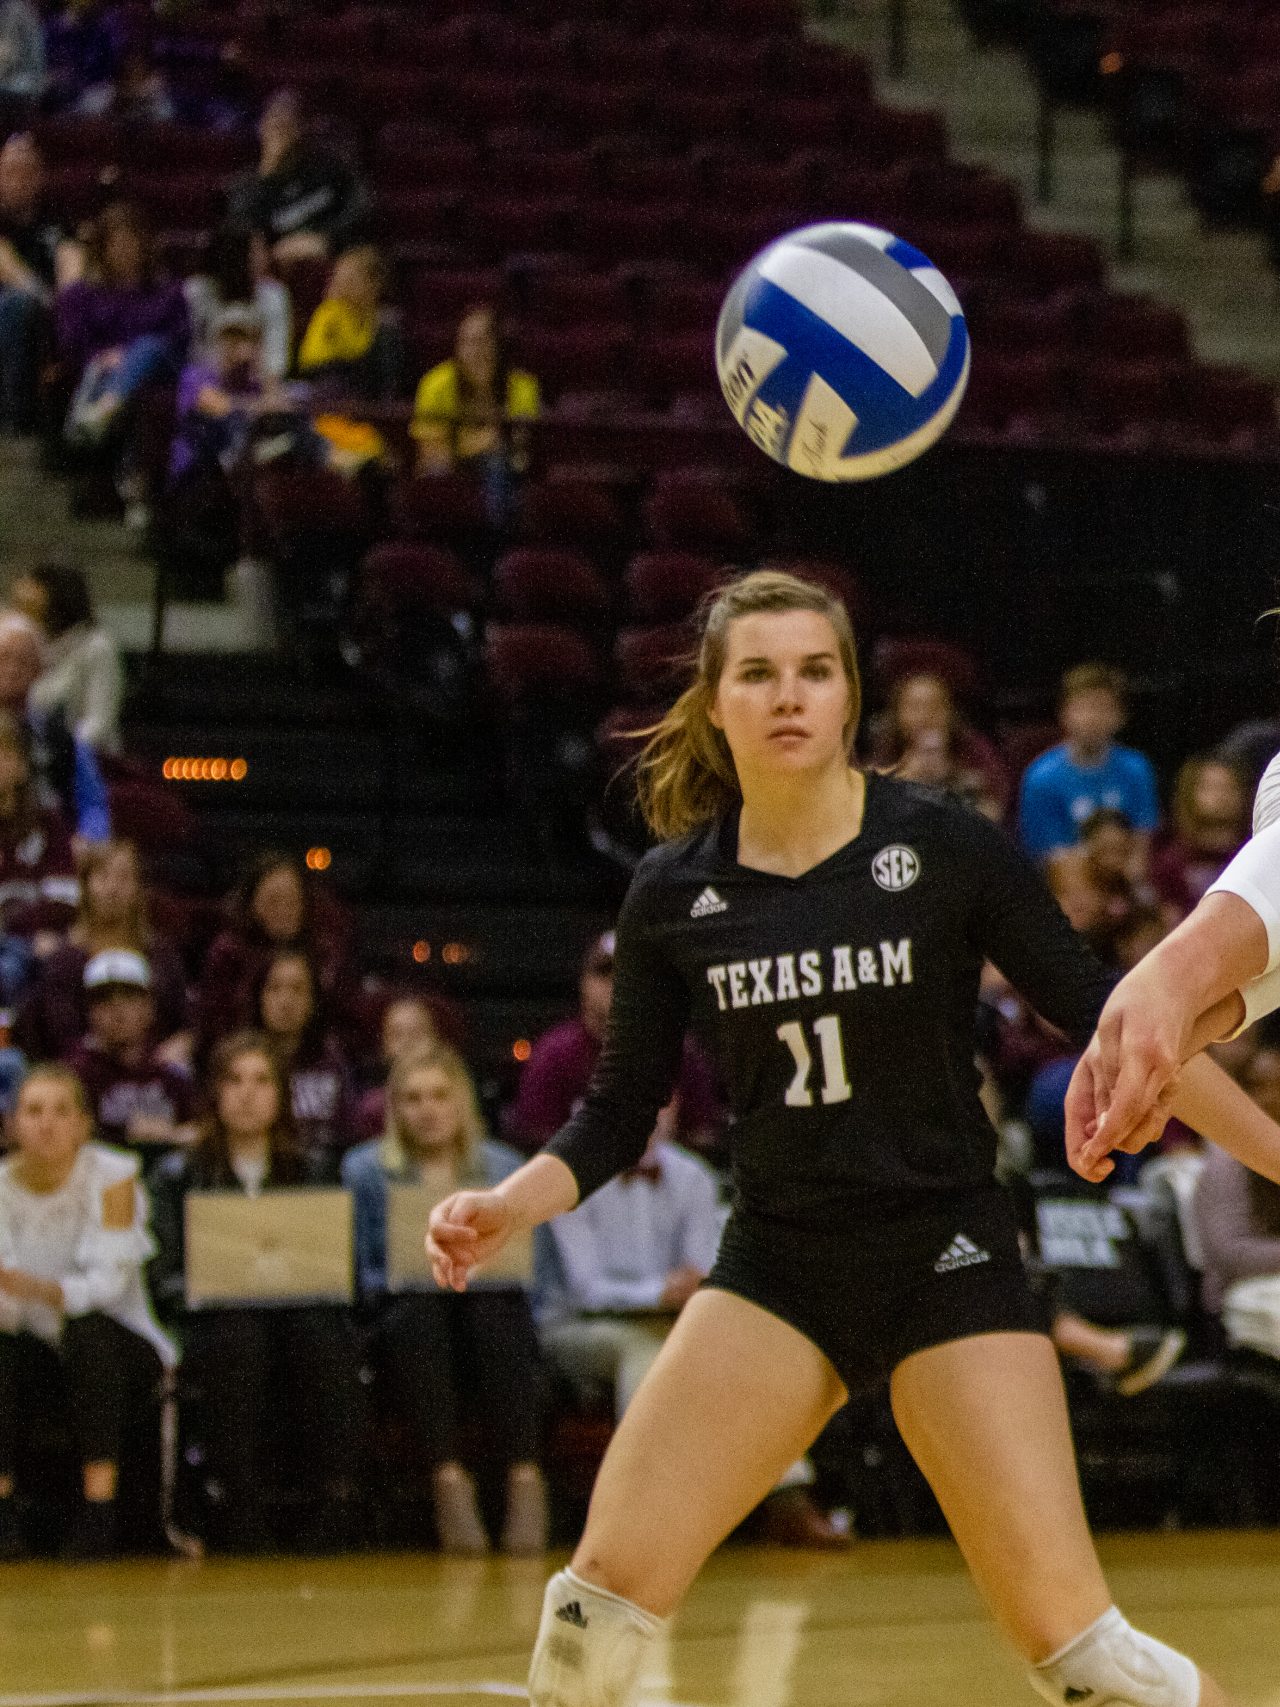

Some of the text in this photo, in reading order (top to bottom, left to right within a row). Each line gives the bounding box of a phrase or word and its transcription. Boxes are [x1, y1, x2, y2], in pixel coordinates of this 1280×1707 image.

[876, 850, 916, 885] SEC
[690, 902, 728, 918] adidas
[707, 938, 912, 1011] TEXAS A&M
[776, 1015, 852, 1108] 11
[934, 1250, 991, 1273] adidas
